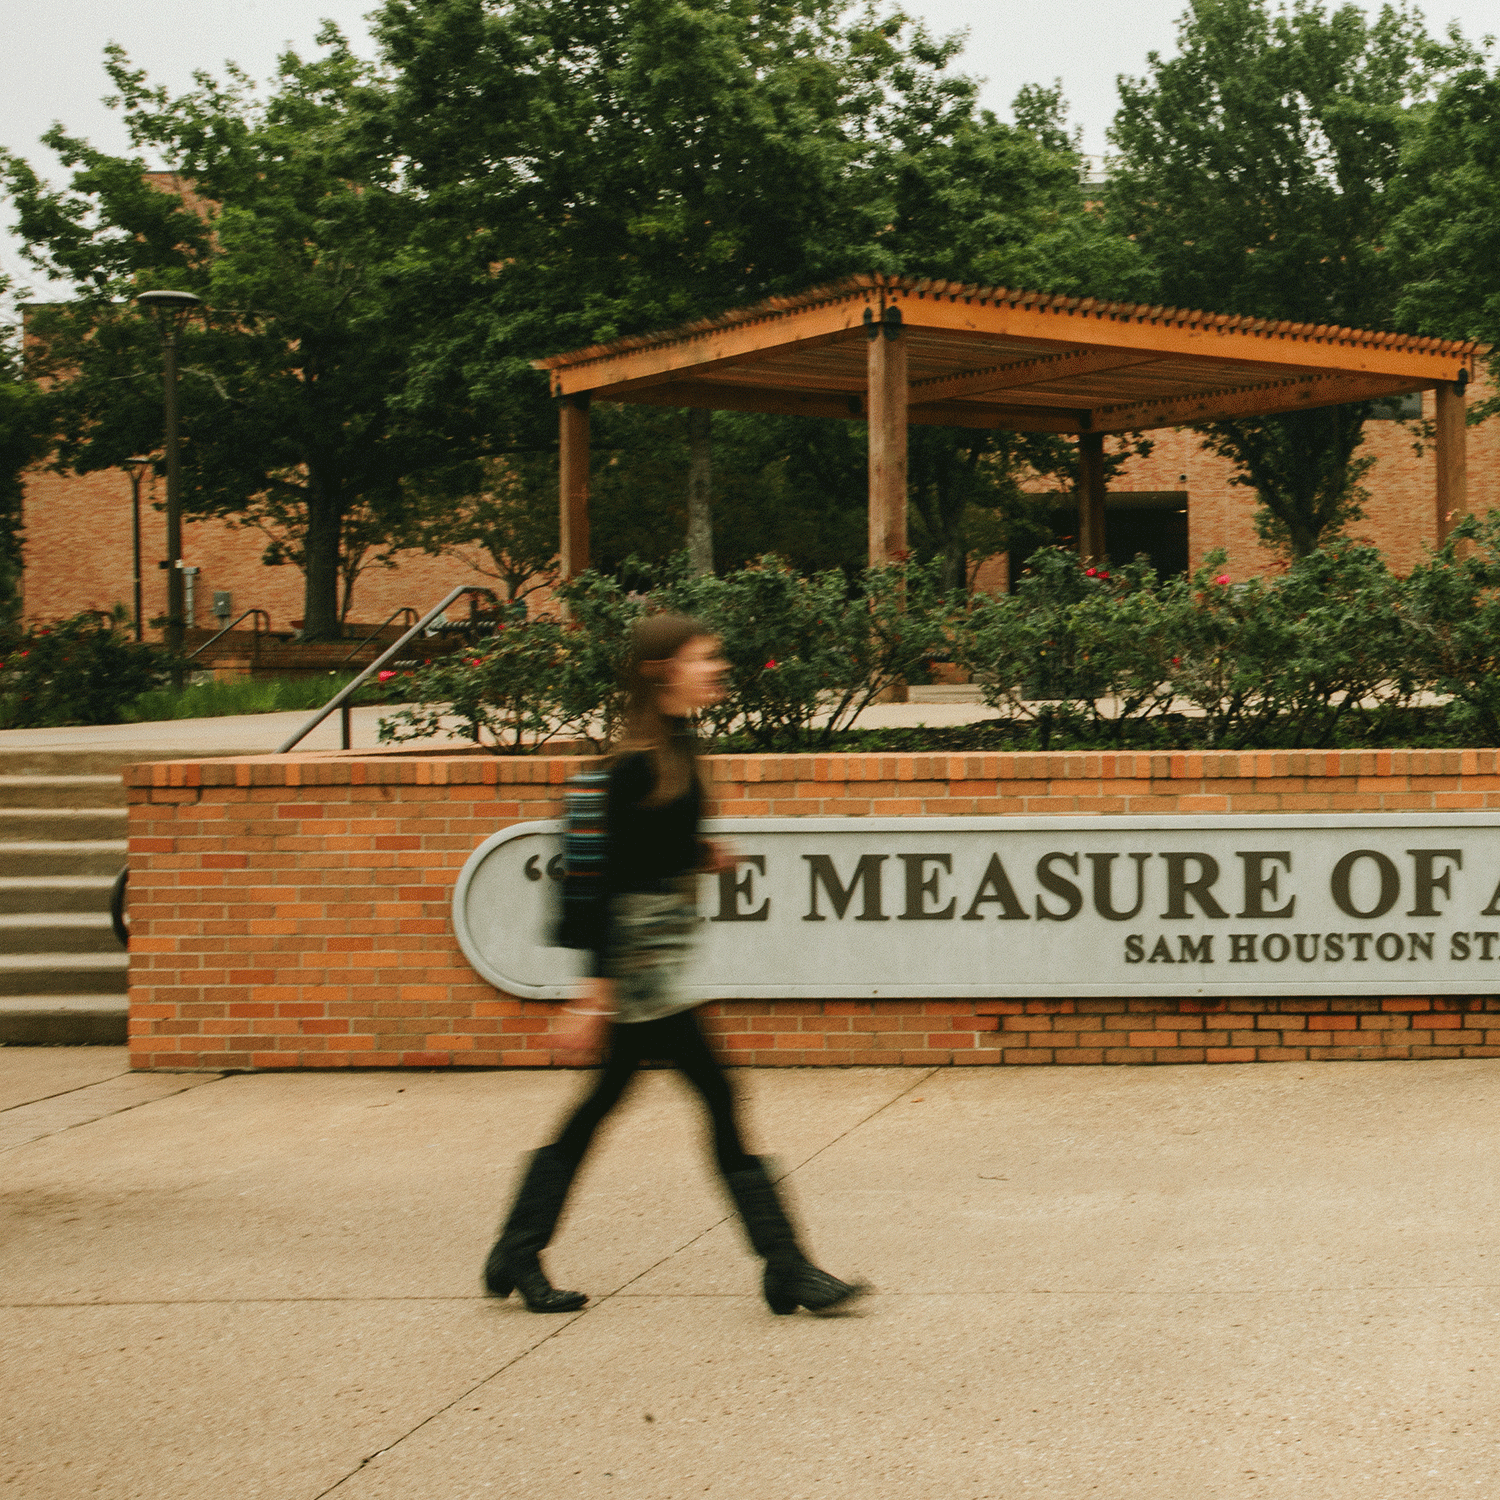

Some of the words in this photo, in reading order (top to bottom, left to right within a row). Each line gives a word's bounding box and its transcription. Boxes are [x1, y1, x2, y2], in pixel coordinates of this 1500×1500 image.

[801, 851, 1296, 922] MEASURE
[1330, 848, 1463, 920] OF
[1124, 934, 1215, 965] SAM
[1228, 932, 1435, 964] HOUSTON
